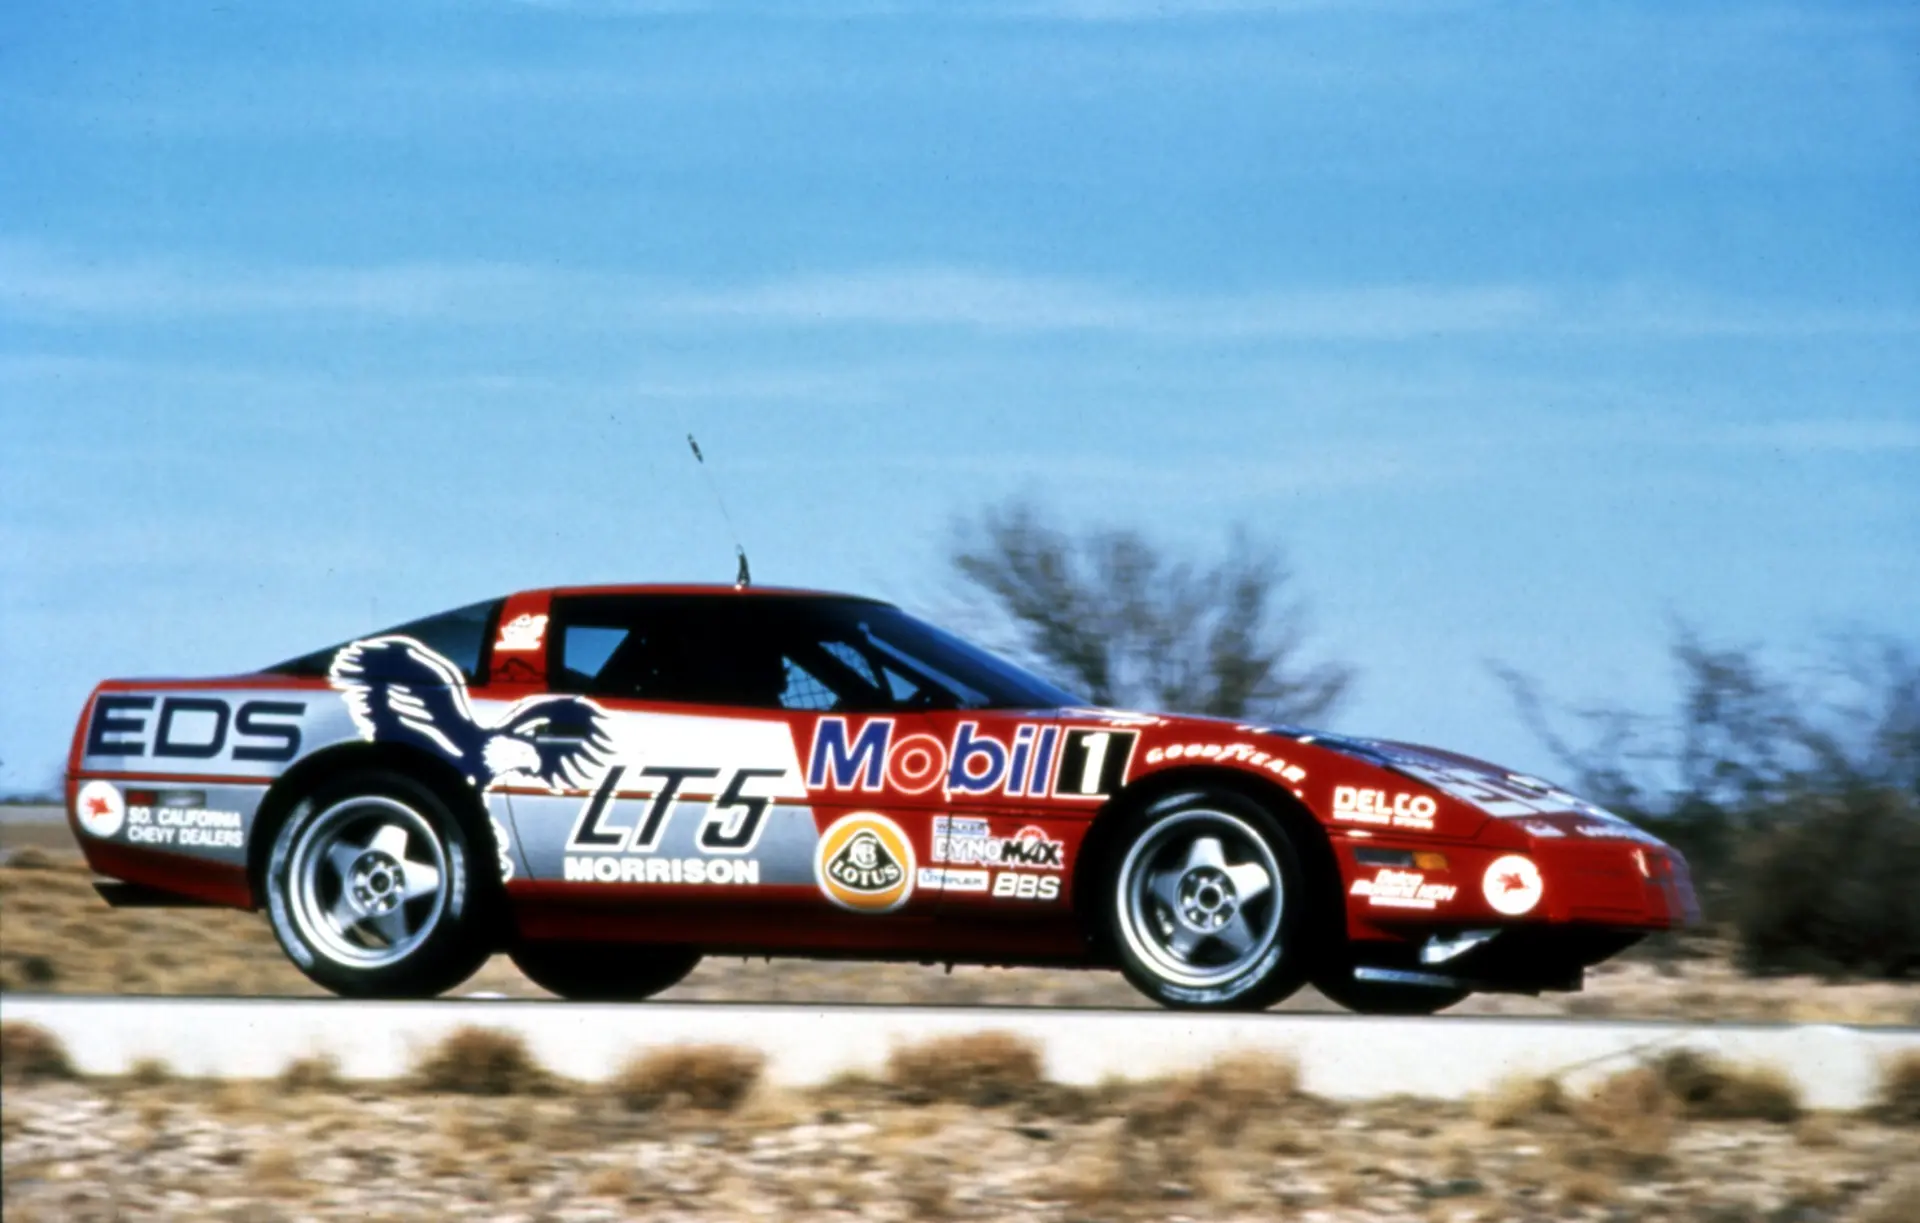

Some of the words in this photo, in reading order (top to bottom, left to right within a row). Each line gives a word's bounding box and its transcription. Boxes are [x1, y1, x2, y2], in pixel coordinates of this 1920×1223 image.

[86, 695, 307, 762] EDS
[806, 716, 1061, 797] Mobil
[1080, 731, 1111, 796] 1
[1145, 743, 1307, 783] GOODYEAR
[568, 765, 790, 850] LT5
[1333, 786, 1437, 818] DELCO
[158, 808, 242, 828] CALIFORNIA
[127, 825, 176, 843] CHEVY
[179, 827, 244, 848] DEALERS
[933, 836, 1062, 867] DYNOMAX
[563, 856, 760, 885] MORRISON
[832, 860, 899, 886] LOTUS
[992, 872, 1062, 900] BBS
